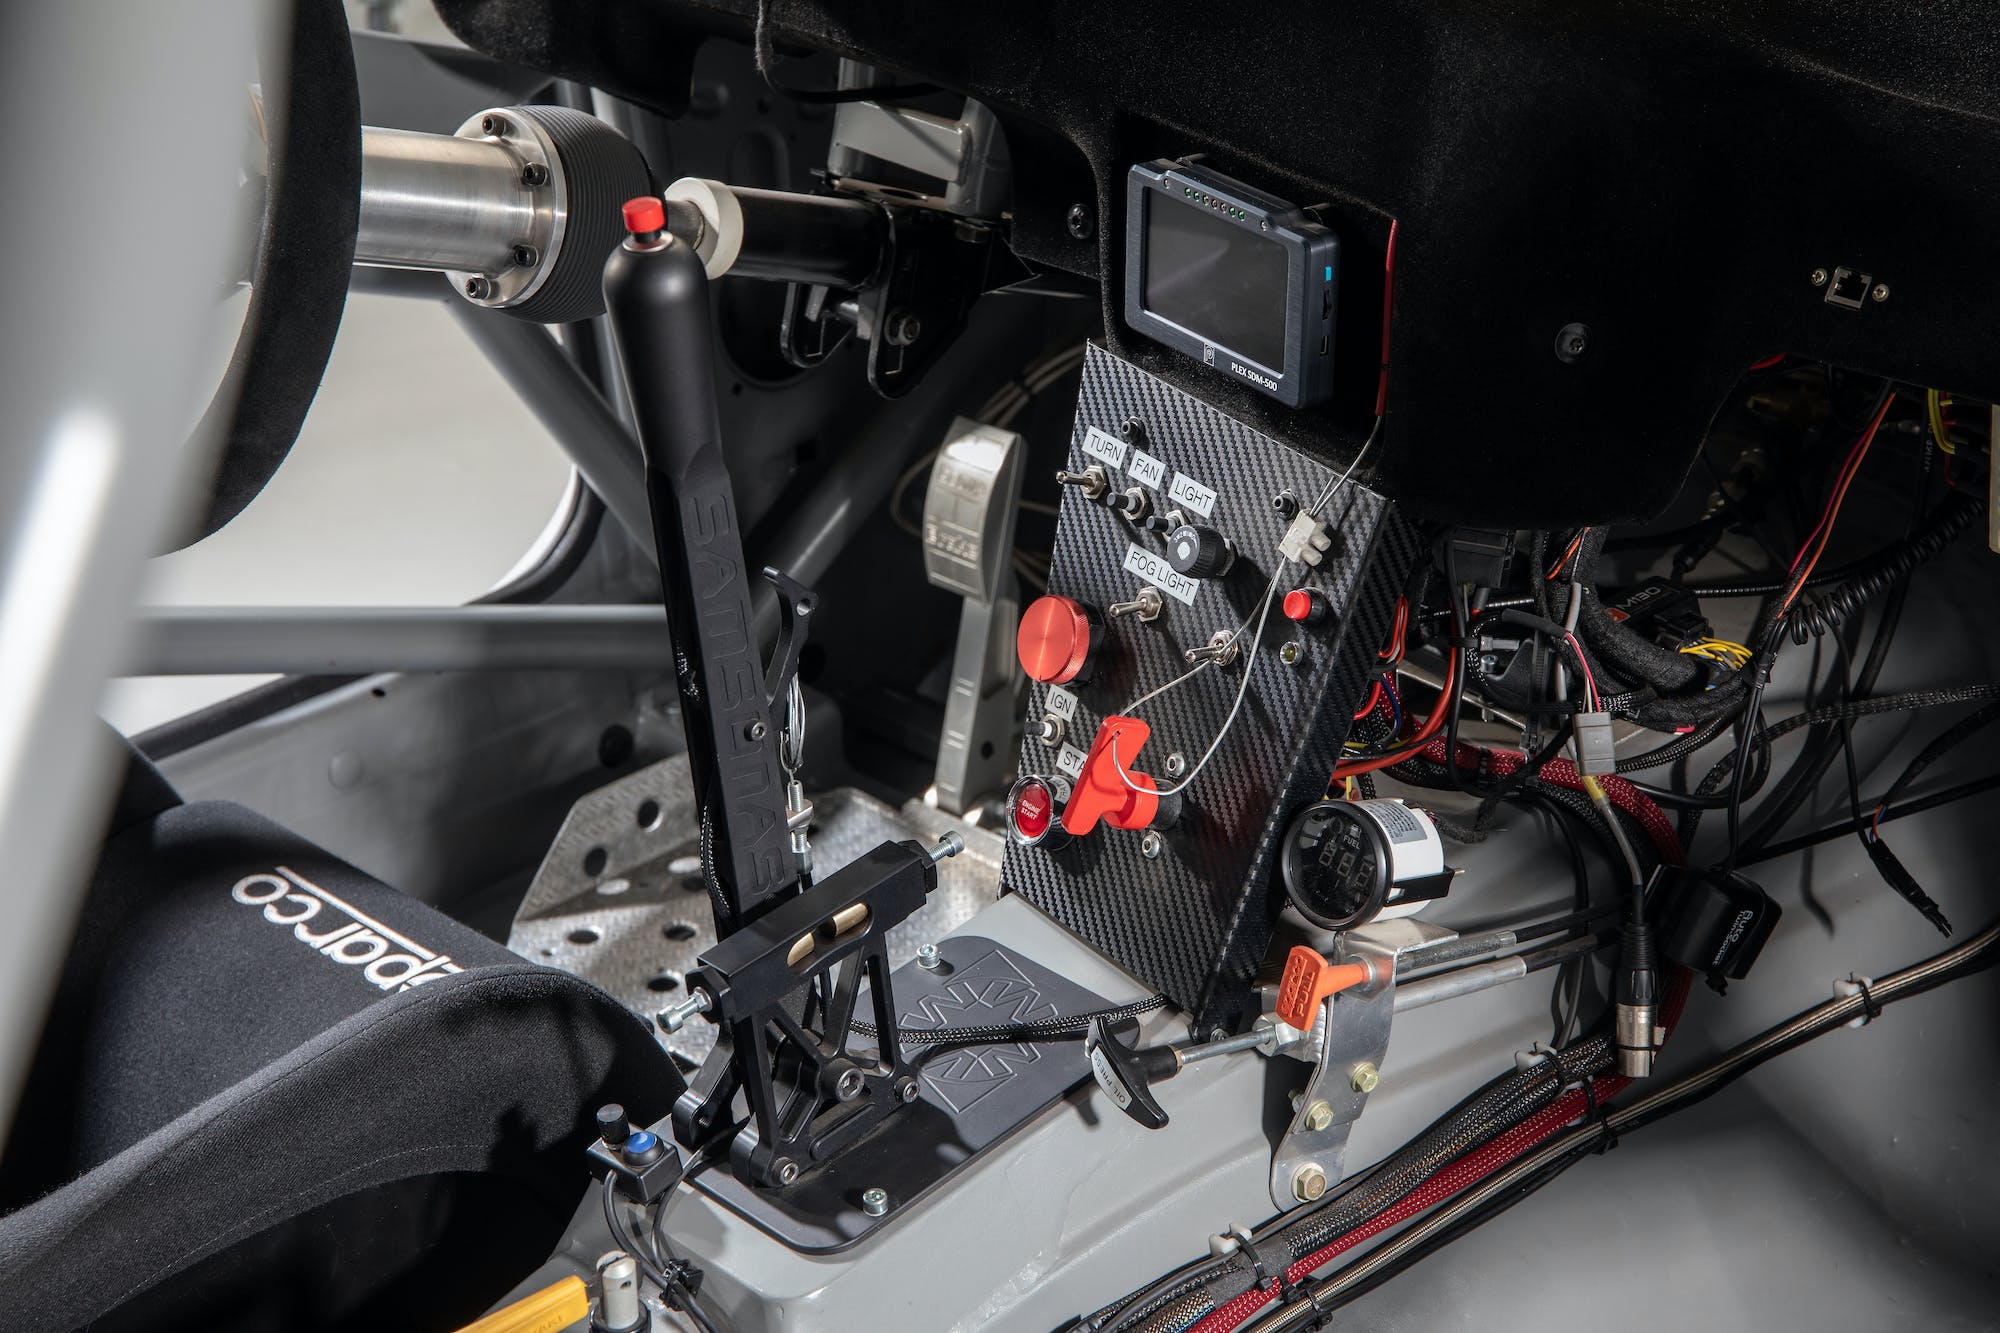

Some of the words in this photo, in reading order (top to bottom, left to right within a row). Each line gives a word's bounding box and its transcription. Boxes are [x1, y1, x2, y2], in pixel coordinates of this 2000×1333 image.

[1231, 361, 1247, 377] PLEX
[1247, 369, 1278, 392] SDM-500
[1088, 432, 1123, 462] TURN
[1132, 458, 1159, 482] FAN
[1174, 481, 1212, 510] LIGHT
[1129, 551, 1156, 579] FOG
[1157, 565, 1195, 598] LIGHT
[1050, 691, 1072, 714] IGN
[1063, 751, 1085, 772] STA
[1020, 808, 1038, 820] START
[1021, 800, 1041, 815] ENGINE
[1343, 835, 1361, 850] FUEL
[1731, 910, 1754, 943] Auto
[1296, 972, 1316, 1017] PULL
[1113, 1086, 1126, 1103] OIL
